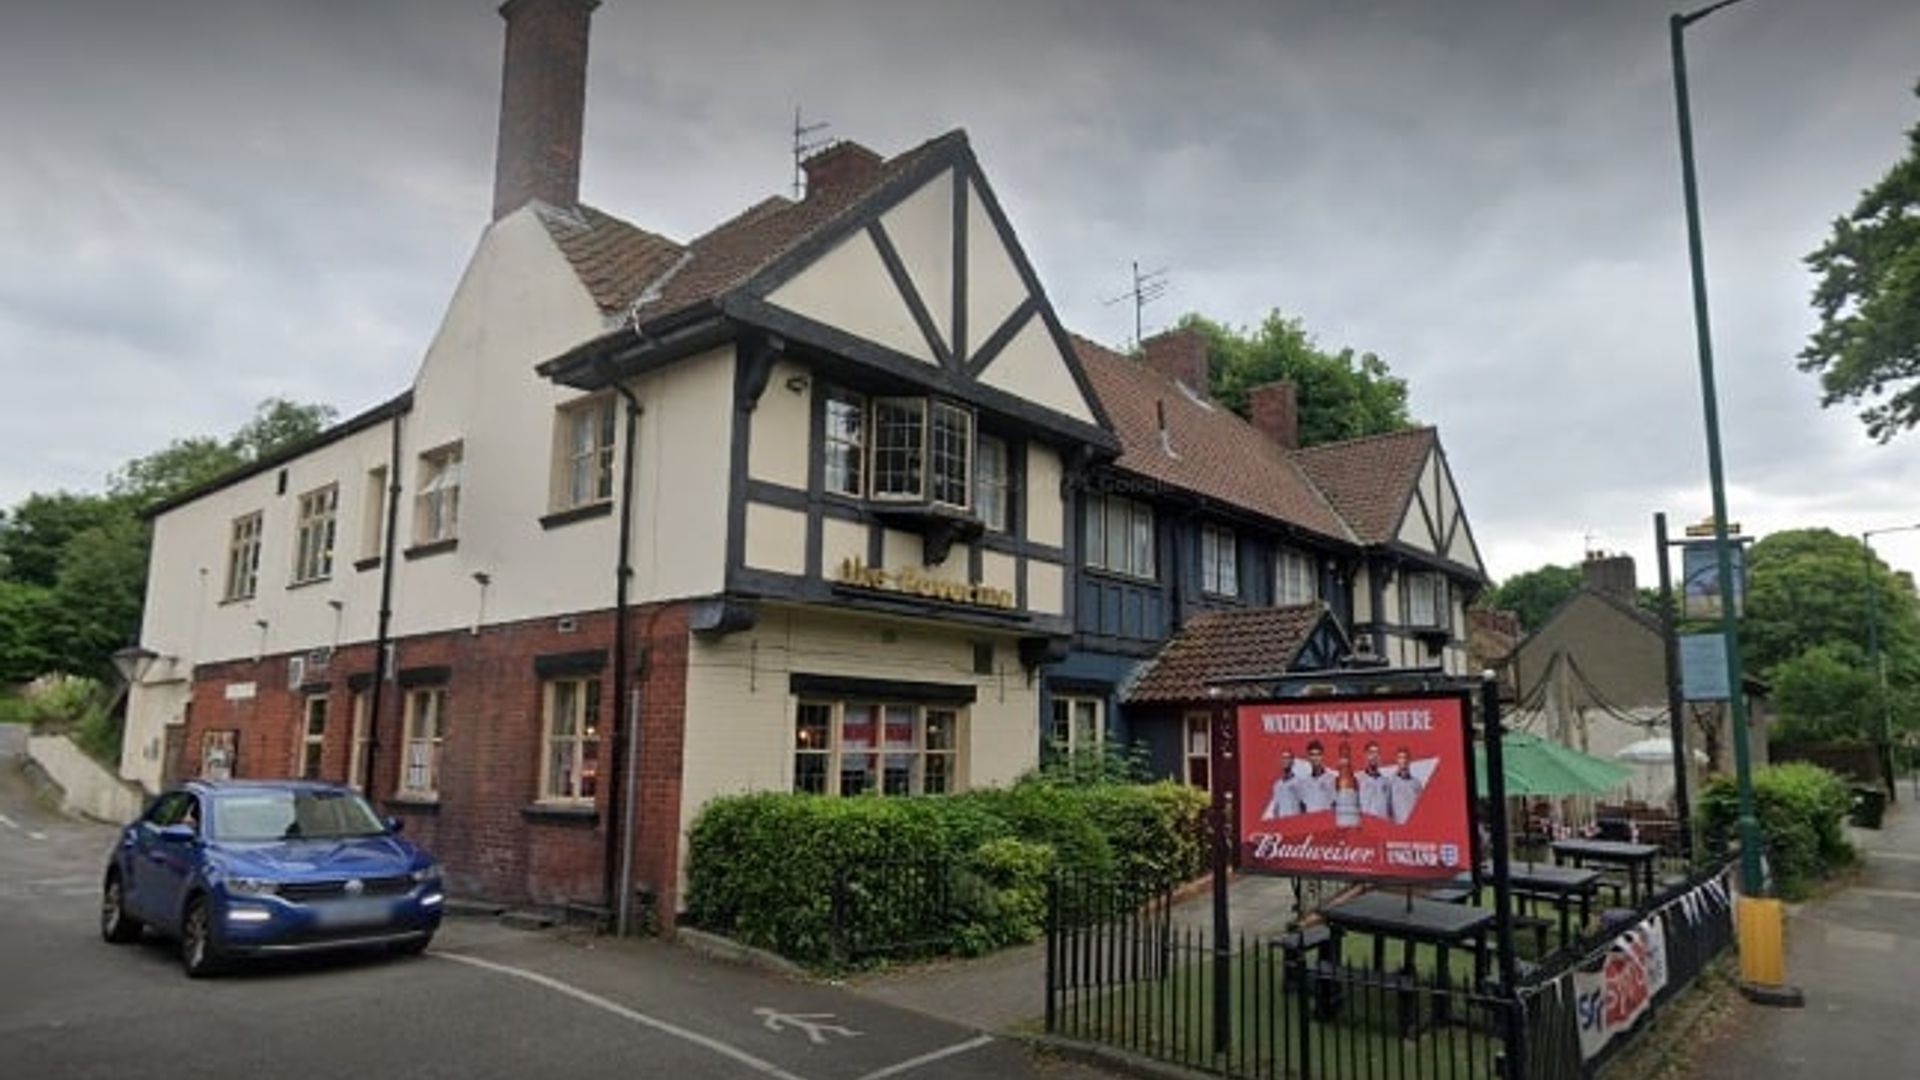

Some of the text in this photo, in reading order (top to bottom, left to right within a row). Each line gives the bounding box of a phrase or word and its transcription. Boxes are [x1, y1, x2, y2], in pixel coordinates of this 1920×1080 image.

[1262, 709, 1434, 733] WATCH ENGLAND HERE
[1251, 832, 1375, 862] Budweiser
